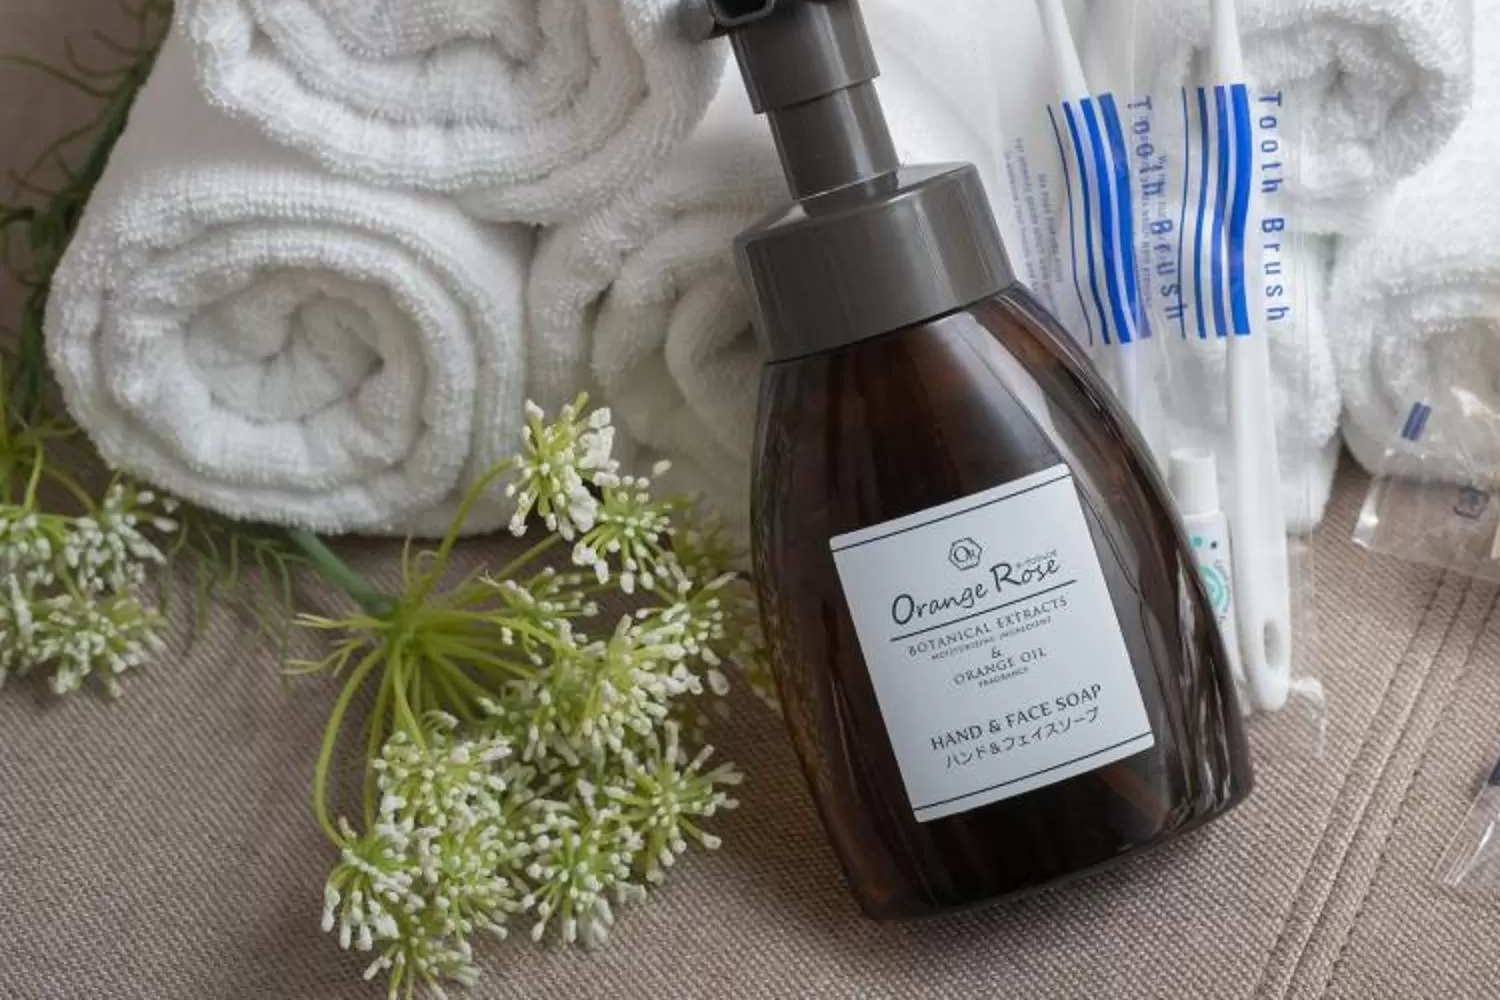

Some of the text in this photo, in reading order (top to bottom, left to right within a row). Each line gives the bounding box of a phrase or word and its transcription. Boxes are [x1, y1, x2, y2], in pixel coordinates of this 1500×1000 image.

[1127, 95, 1189, 321] Tooth Brush
[1257, 90, 1291, 322] Tooth Brush
[891, 581, 989, 625] Orange
[990, 557, 1060, 592] Rose
[907, 597, 1068, 657] BOTANICAL EXTRACTS
[990, 646, 1002, 660] &
[952, 647, 1047, 686] ORANGE OIL
[930, 683, 1104, 751] HAND & FACE SOAP
